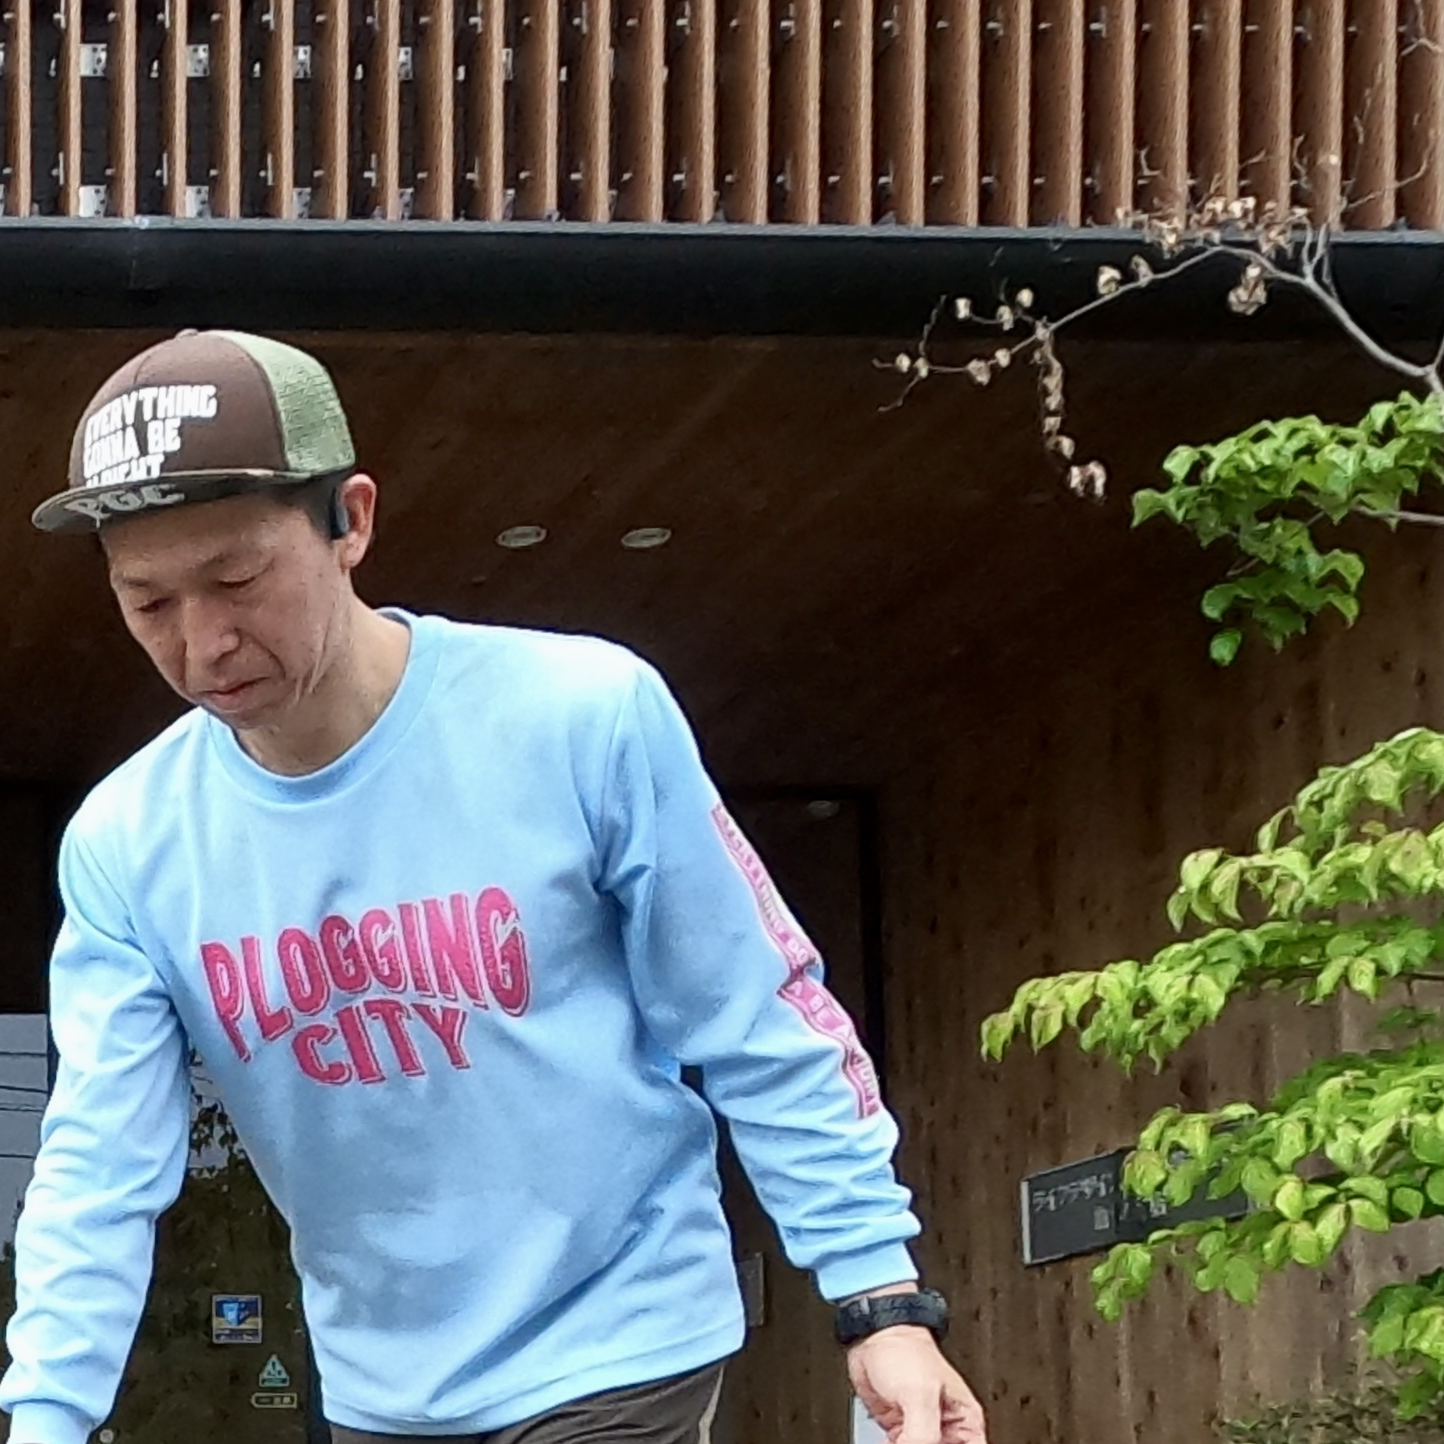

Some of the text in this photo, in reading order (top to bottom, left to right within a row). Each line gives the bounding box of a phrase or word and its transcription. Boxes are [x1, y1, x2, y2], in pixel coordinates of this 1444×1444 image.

[147, 416, 181, 455] BE
[200, 886, 531, 1062] PLOGGING
[292, 998, 471, 1085] CITY
